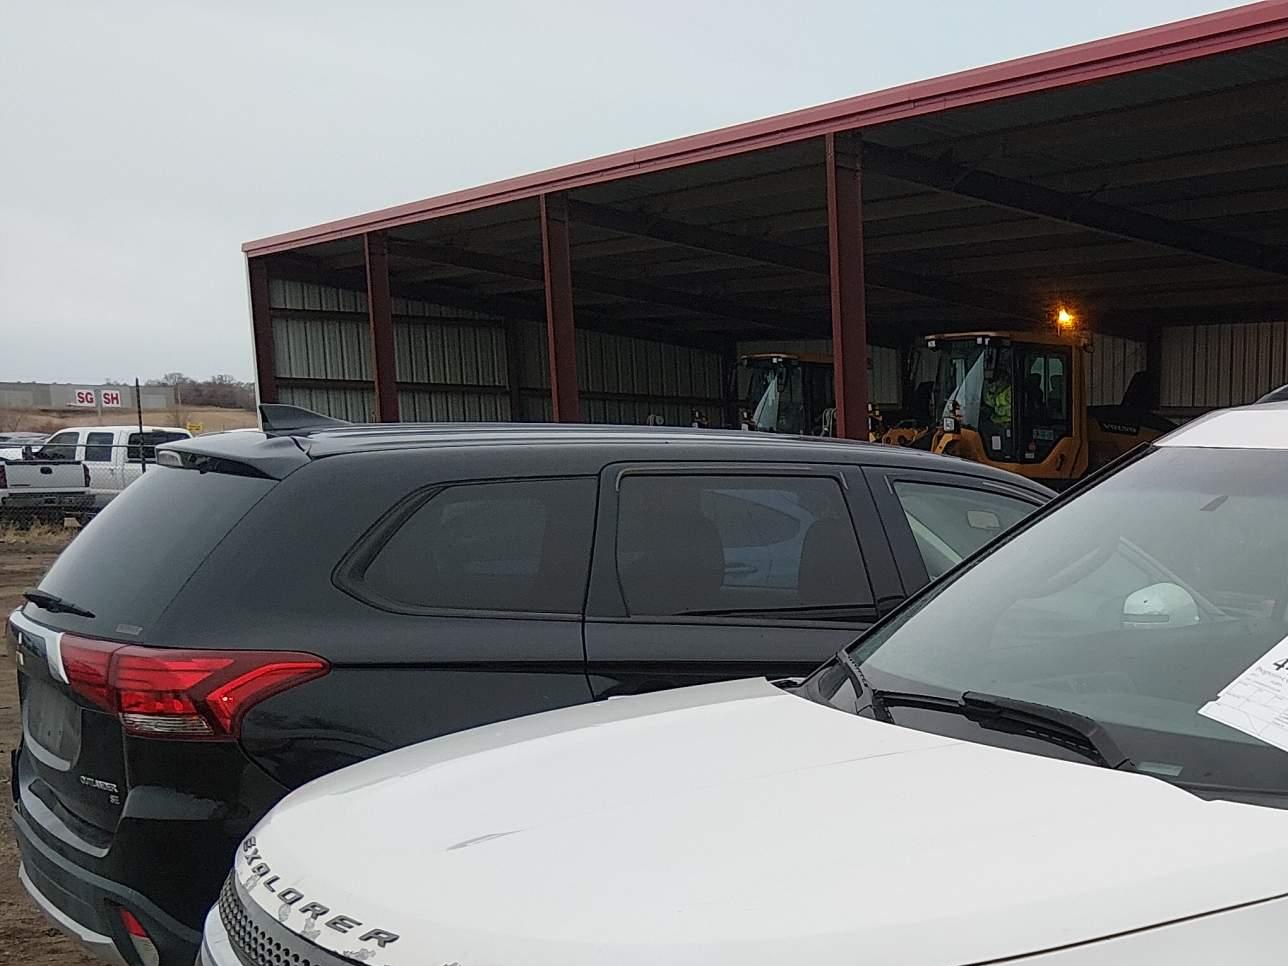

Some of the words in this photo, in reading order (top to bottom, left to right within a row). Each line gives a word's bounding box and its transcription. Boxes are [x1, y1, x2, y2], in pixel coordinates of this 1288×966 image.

[77, 391, 95, 404] SG
[103, 392, 120, 405] SH
[242, 835, 400, 949] EXPLORER
